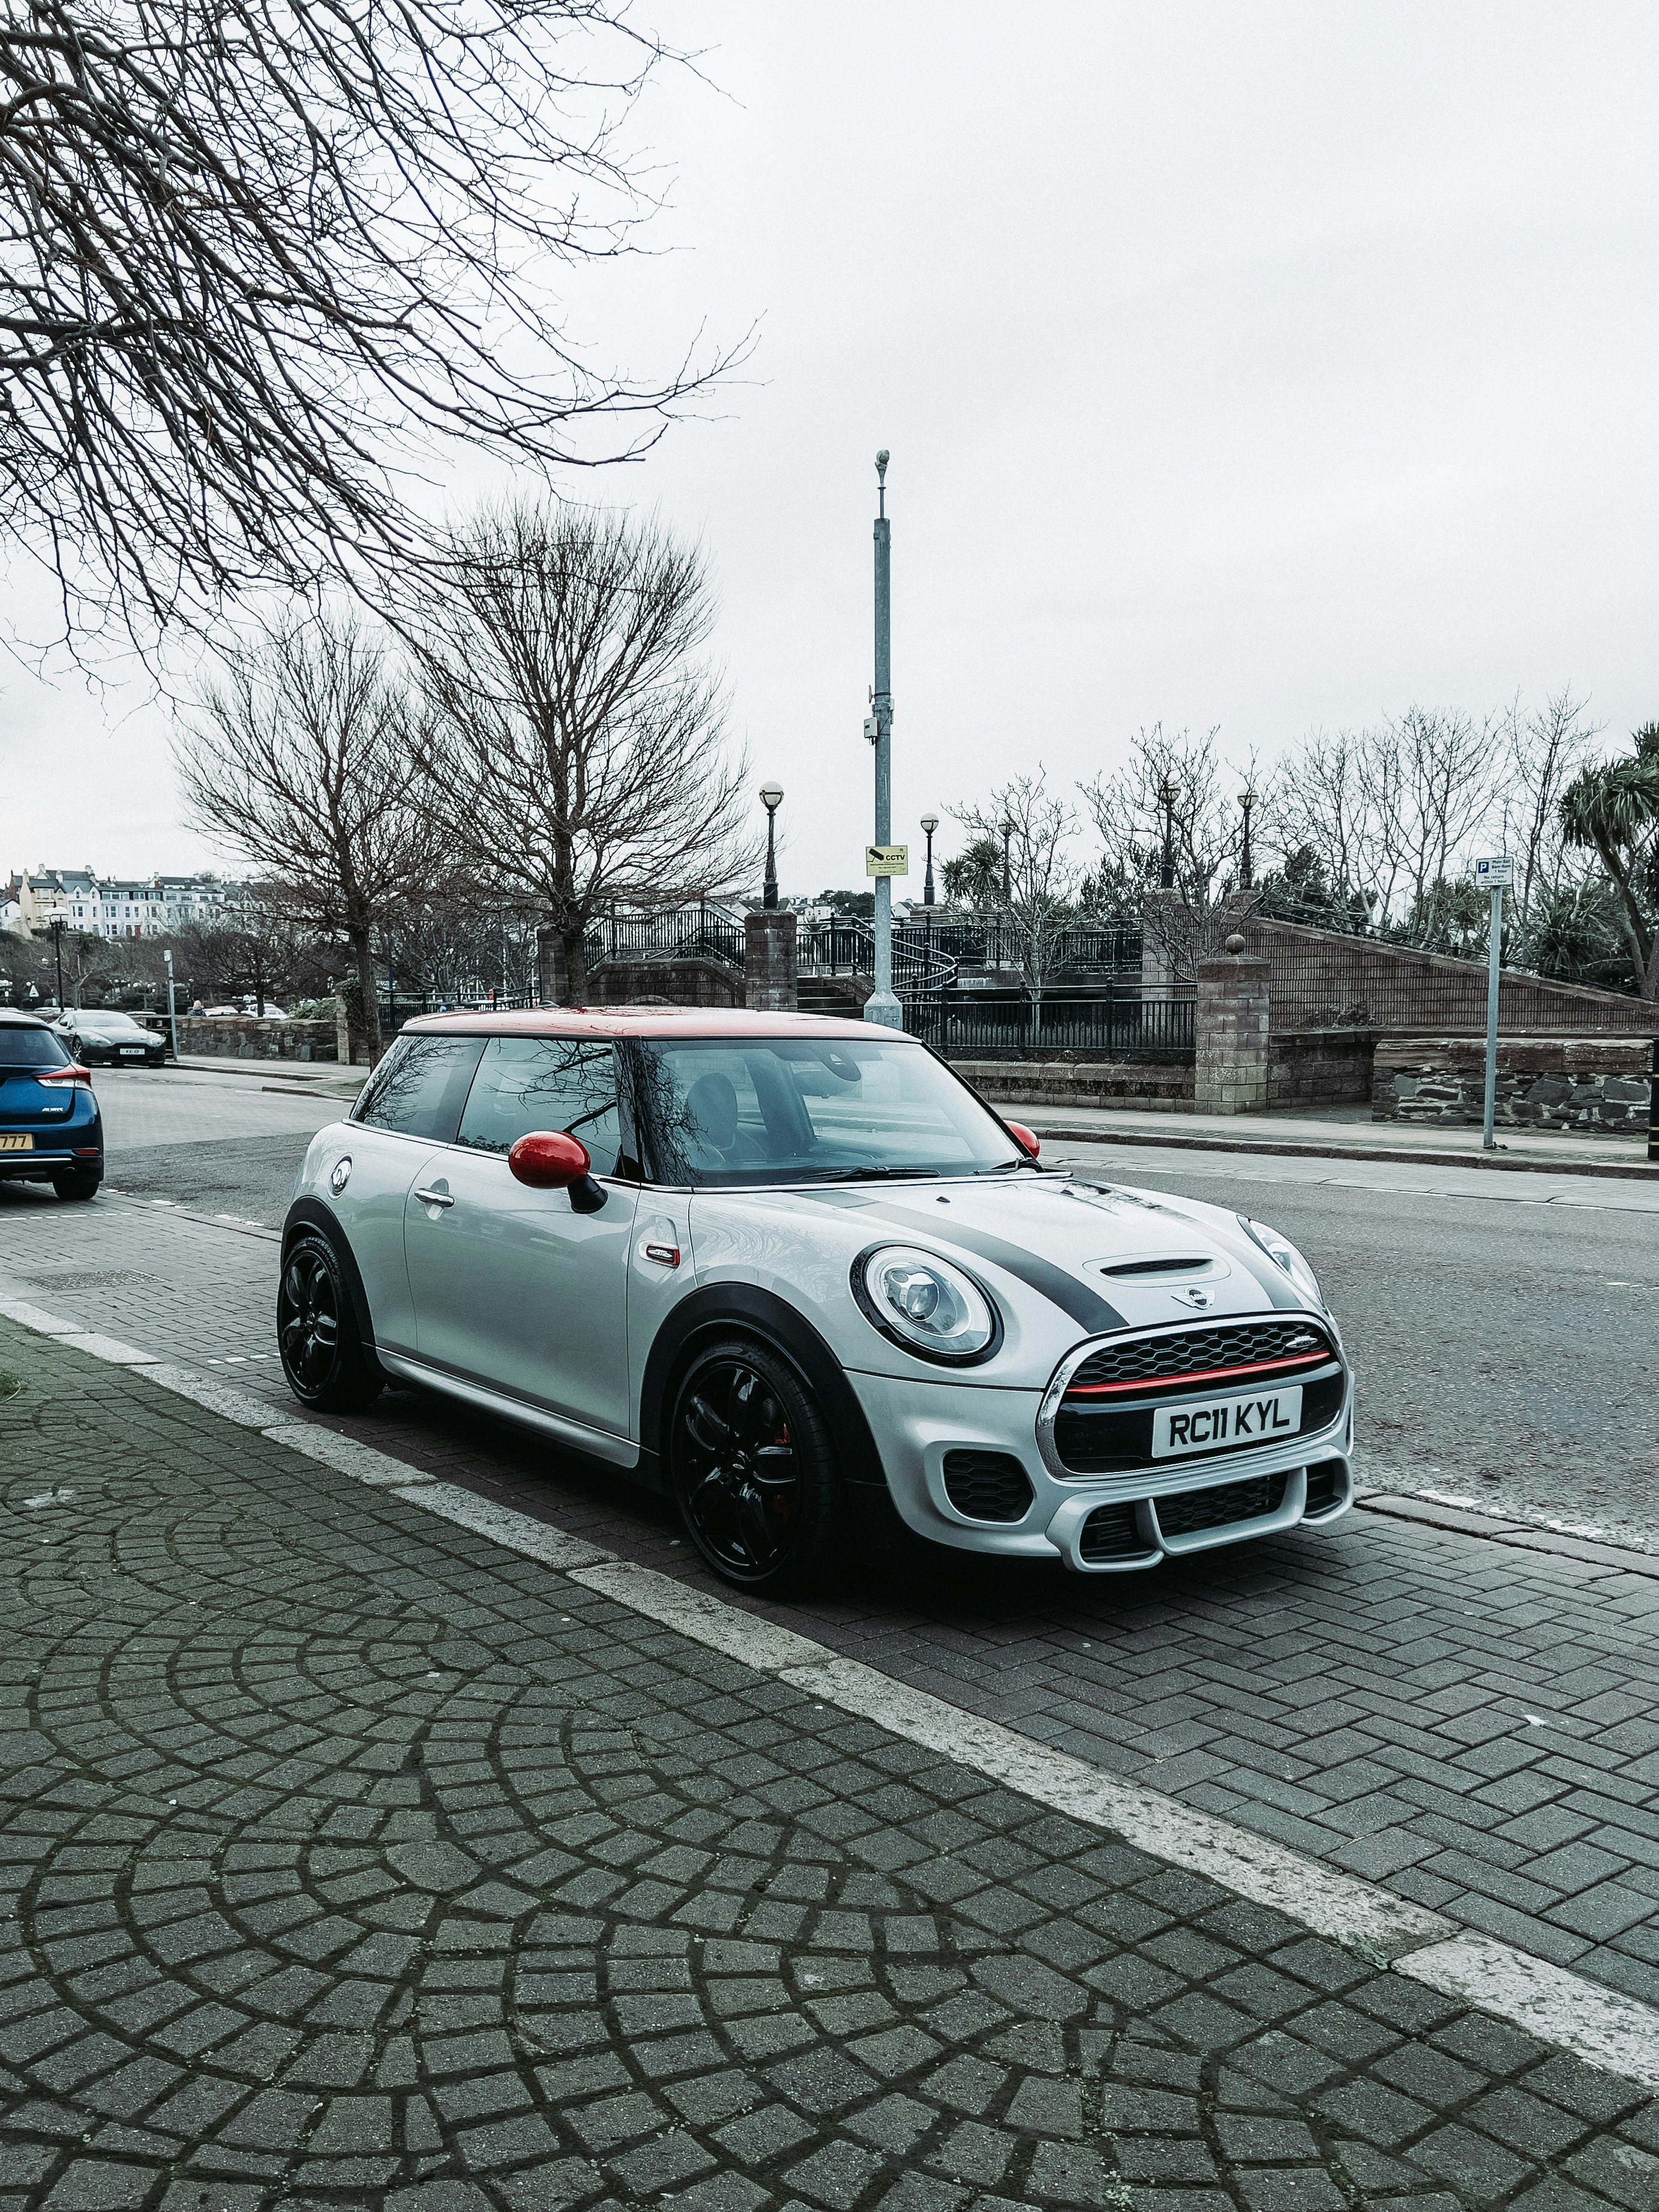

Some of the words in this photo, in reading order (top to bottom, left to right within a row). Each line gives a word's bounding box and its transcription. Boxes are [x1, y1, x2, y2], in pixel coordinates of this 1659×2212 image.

[1480, 863, 1487, 872] P
[0, 1136, 26, 1148] 777
[1169, 1407, 1228, 1447] RC11
[1235, 1398, 1290, 1436] KYL
